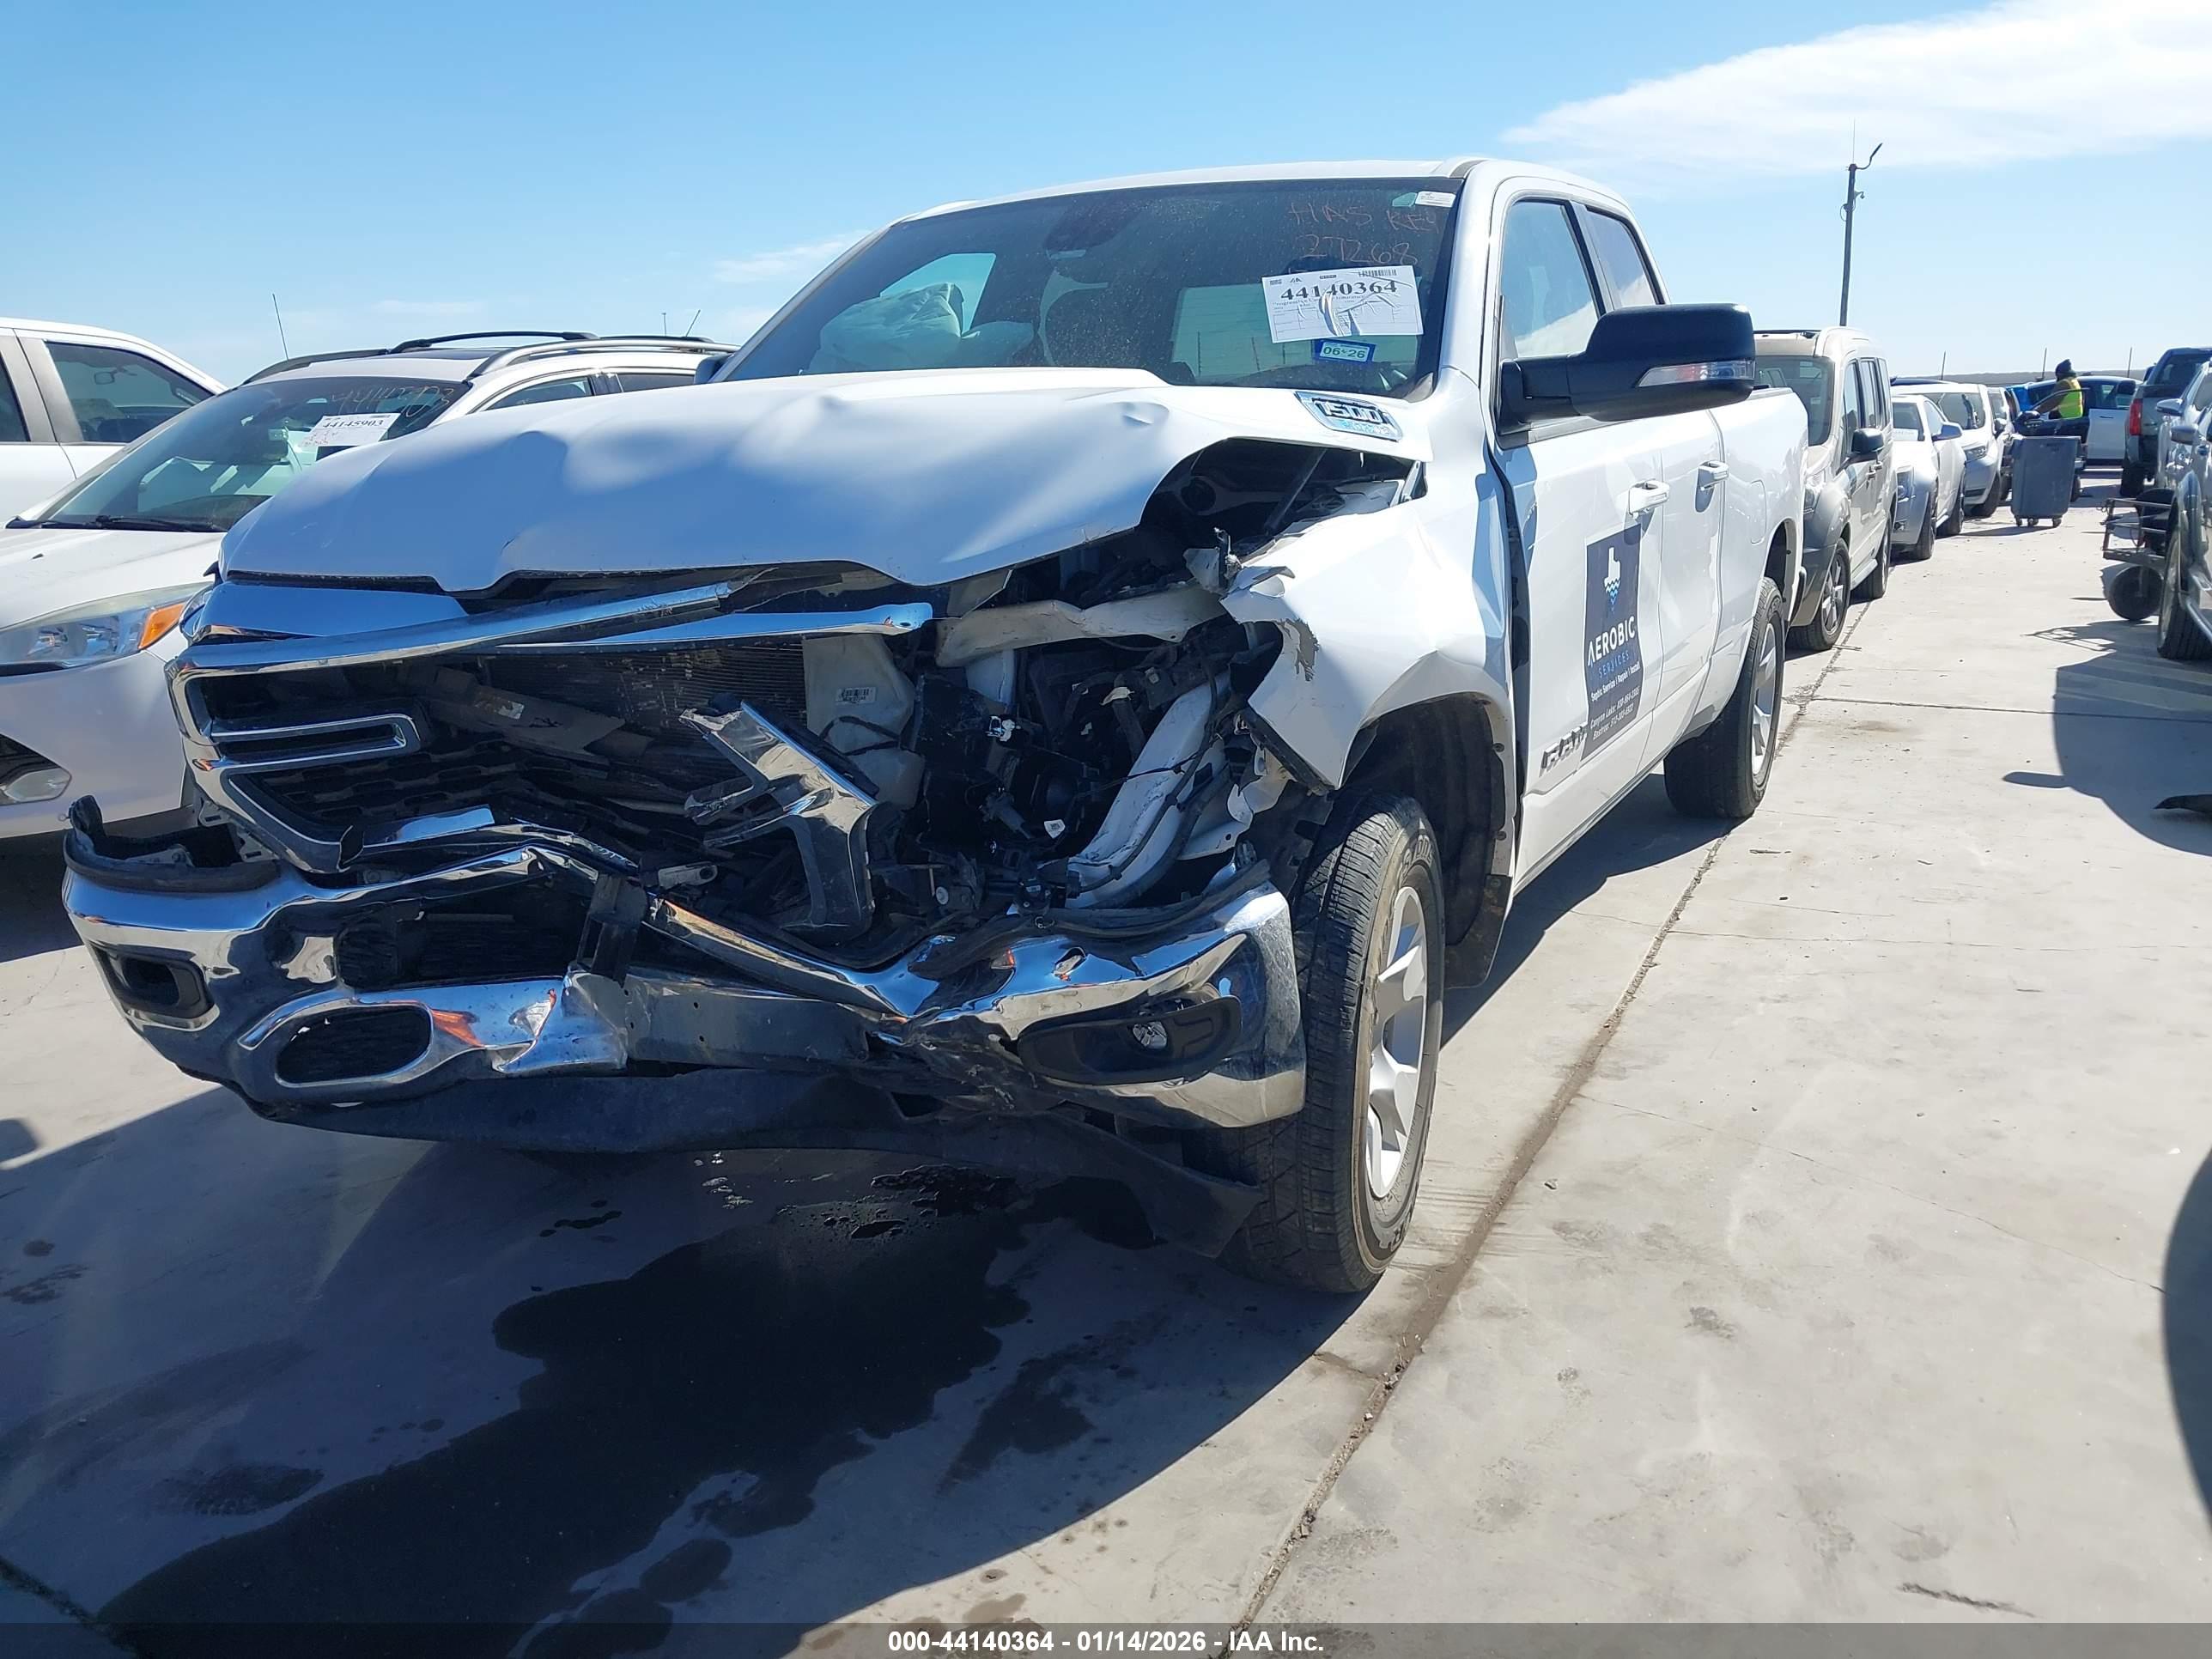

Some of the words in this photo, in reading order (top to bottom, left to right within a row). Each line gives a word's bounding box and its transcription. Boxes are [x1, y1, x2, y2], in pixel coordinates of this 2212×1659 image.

[1280, 280, 1397, 300] 44140364
[1587, 616, 1636, 667] AEROBIC
[1598, 650, 1630, 678] SERVICES
